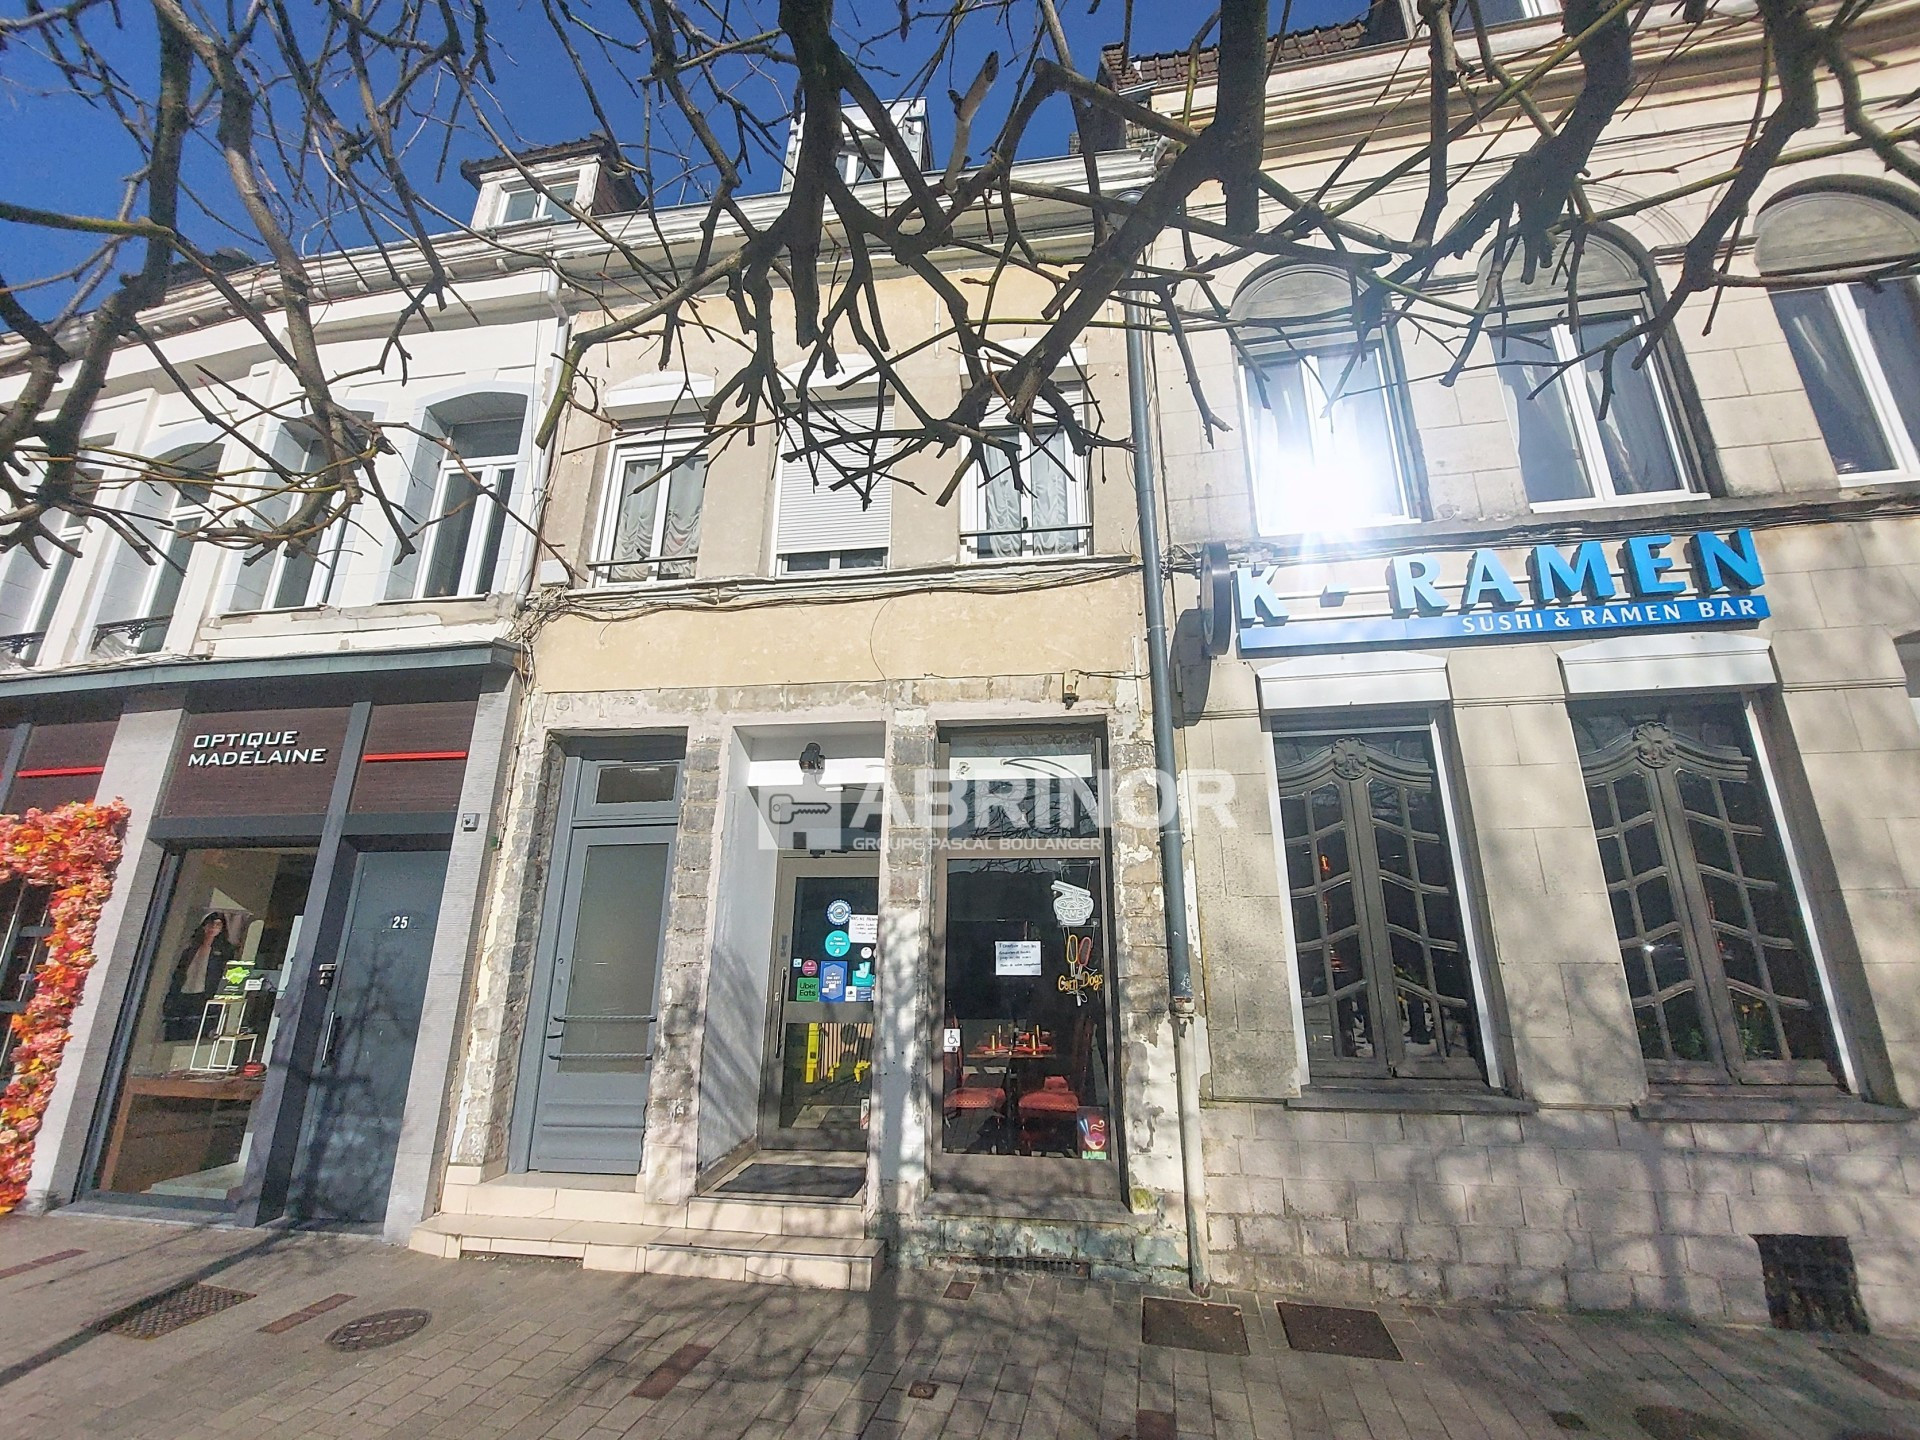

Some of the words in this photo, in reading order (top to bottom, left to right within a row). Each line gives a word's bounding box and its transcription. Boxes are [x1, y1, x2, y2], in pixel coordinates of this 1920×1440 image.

[1236, 564, 1288, 622] K
[1391, 527, 1766, 614] RAMEN
[1462, 613, 1543, 634] SUSHI
[1554, 611, 1572, 629] &
[1581, 604, 1681, 626] RAMEN
[1700, 599, 1757, 619] BAR
[193, 730, 298, 748] OPTIQUE
[188, 748, 327, 767] MADELAINE
[392, 916, 409, 929] 25
[1081, 970, 1104, 991] Dogs
[799, 989, 816, 997] Eats
